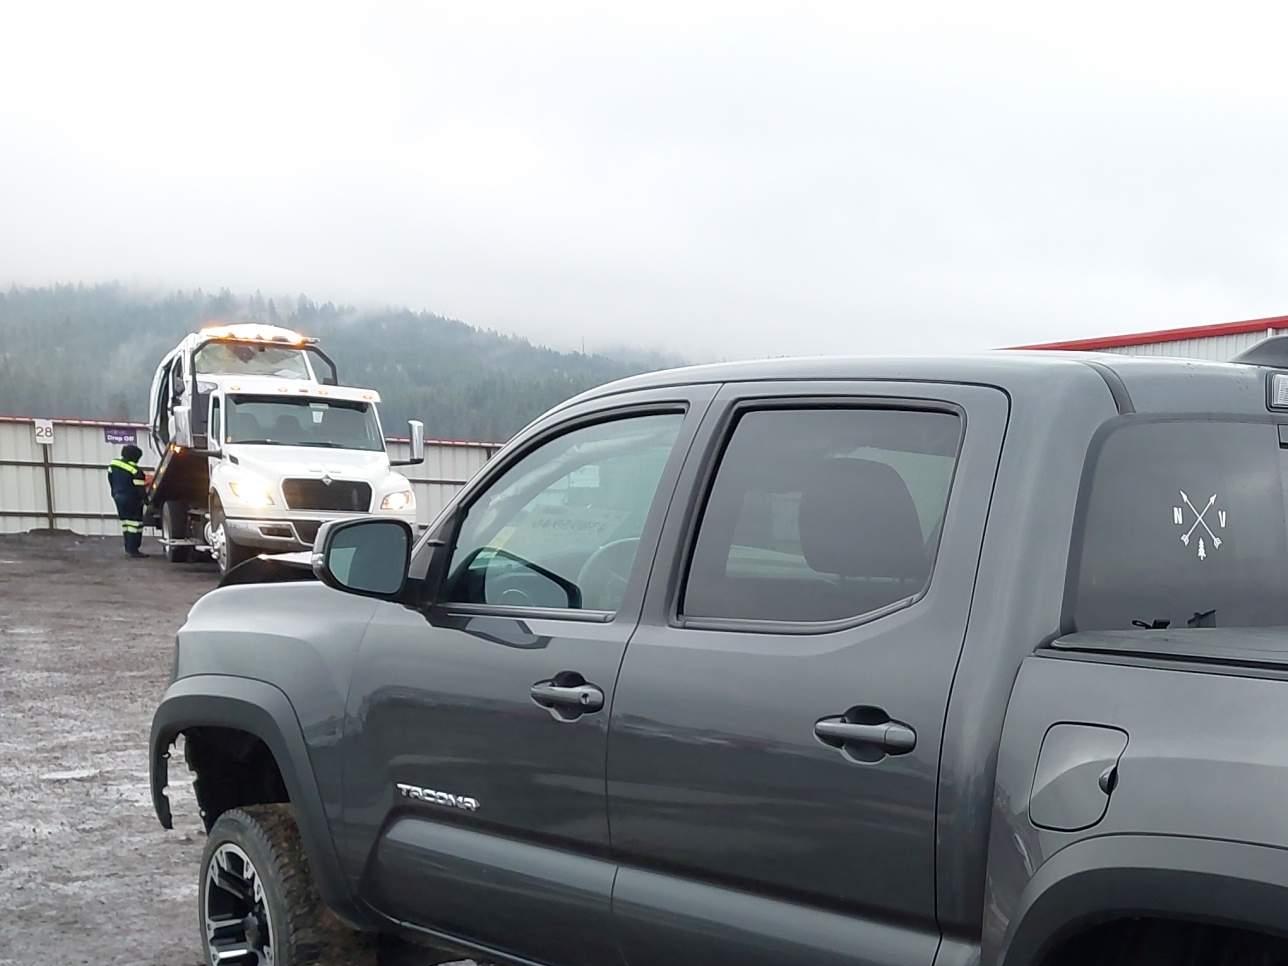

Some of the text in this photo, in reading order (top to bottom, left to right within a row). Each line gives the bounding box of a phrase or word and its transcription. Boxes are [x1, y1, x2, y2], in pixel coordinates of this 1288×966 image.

[36, 426, 53, 438] 28
[1173, 507, 1226, 528] N V
[396, 783, 481, 811] TACOMA
